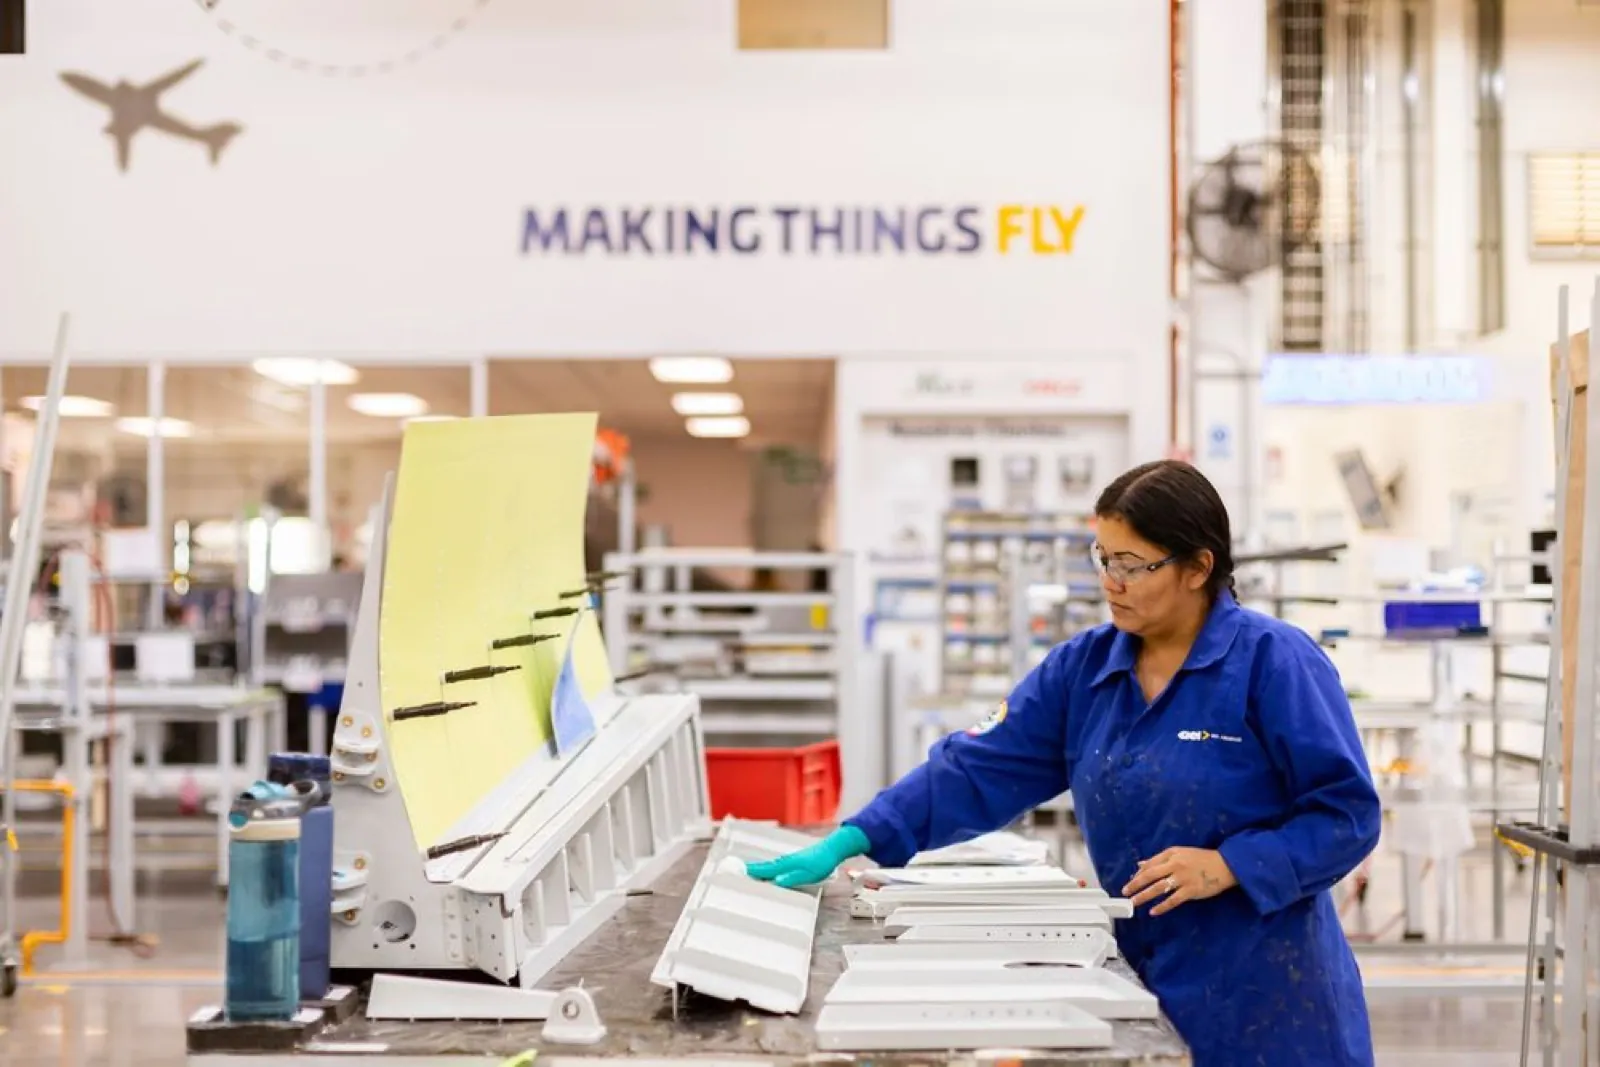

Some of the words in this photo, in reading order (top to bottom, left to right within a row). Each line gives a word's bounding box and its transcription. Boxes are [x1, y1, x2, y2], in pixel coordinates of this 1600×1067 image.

[520, 205, 762, 255] MAKING
[770, 205, 983, 255] THINGS
[996, 205, 1086, 254] FLY
